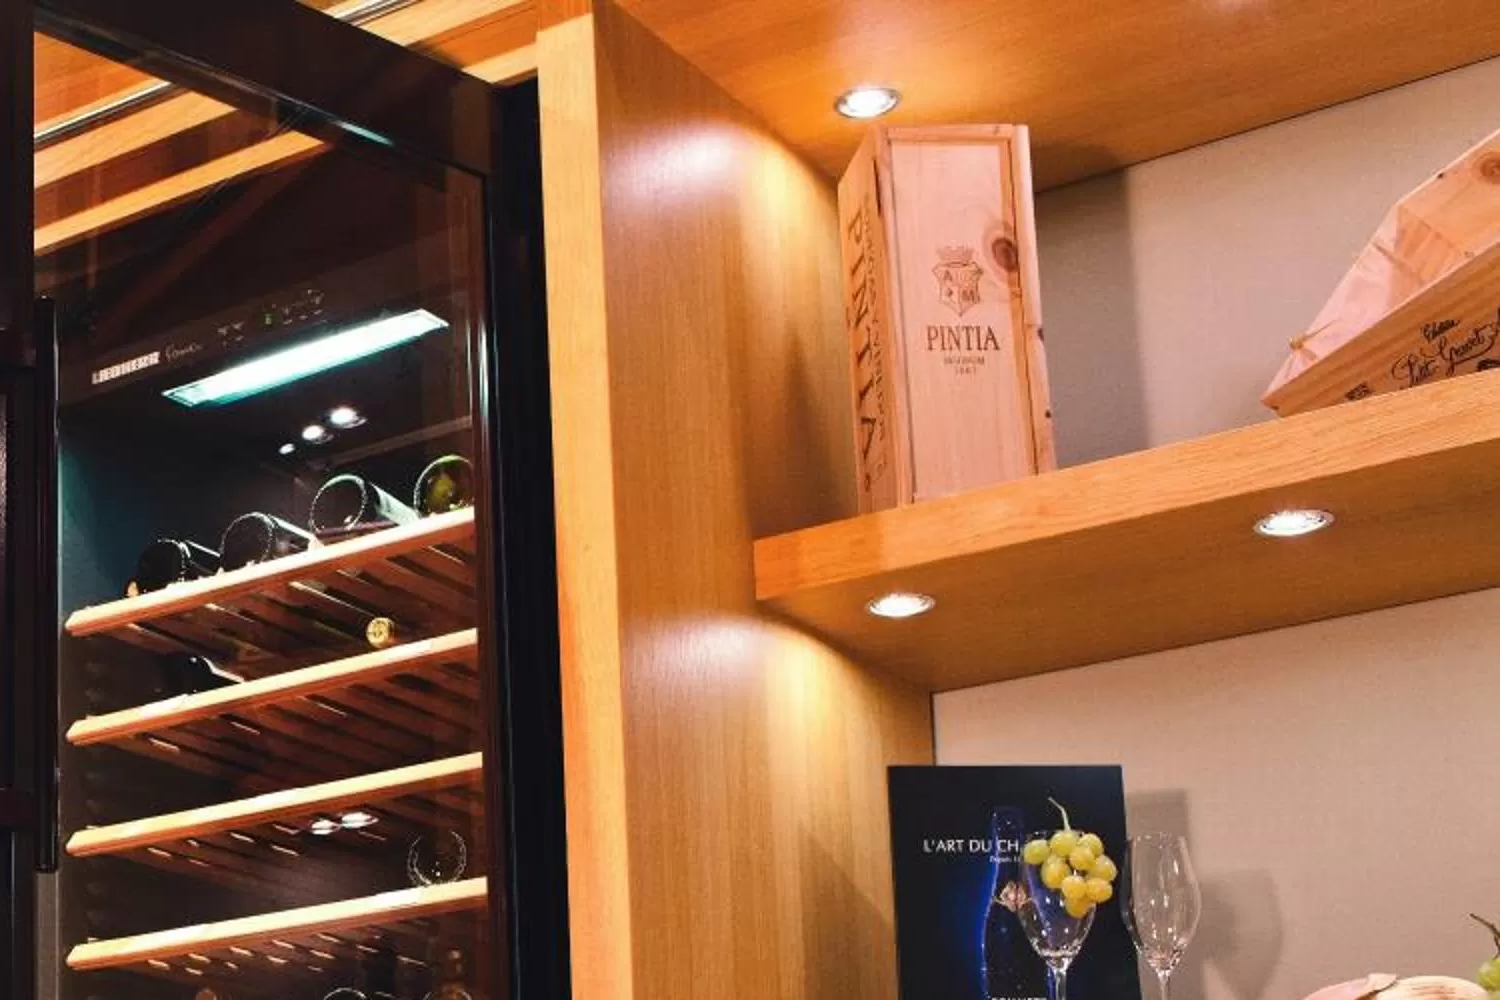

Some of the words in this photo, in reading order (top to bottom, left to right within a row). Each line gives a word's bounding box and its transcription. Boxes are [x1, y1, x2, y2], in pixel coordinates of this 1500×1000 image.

[848, 204, 878, 462] PINTIA
[926, 325, 1001, 352] PINTIA
[923, 838, 964, 853] L'ART
[969, 838, 992, 853] DU
[997, 838, 1020, 853] CH
